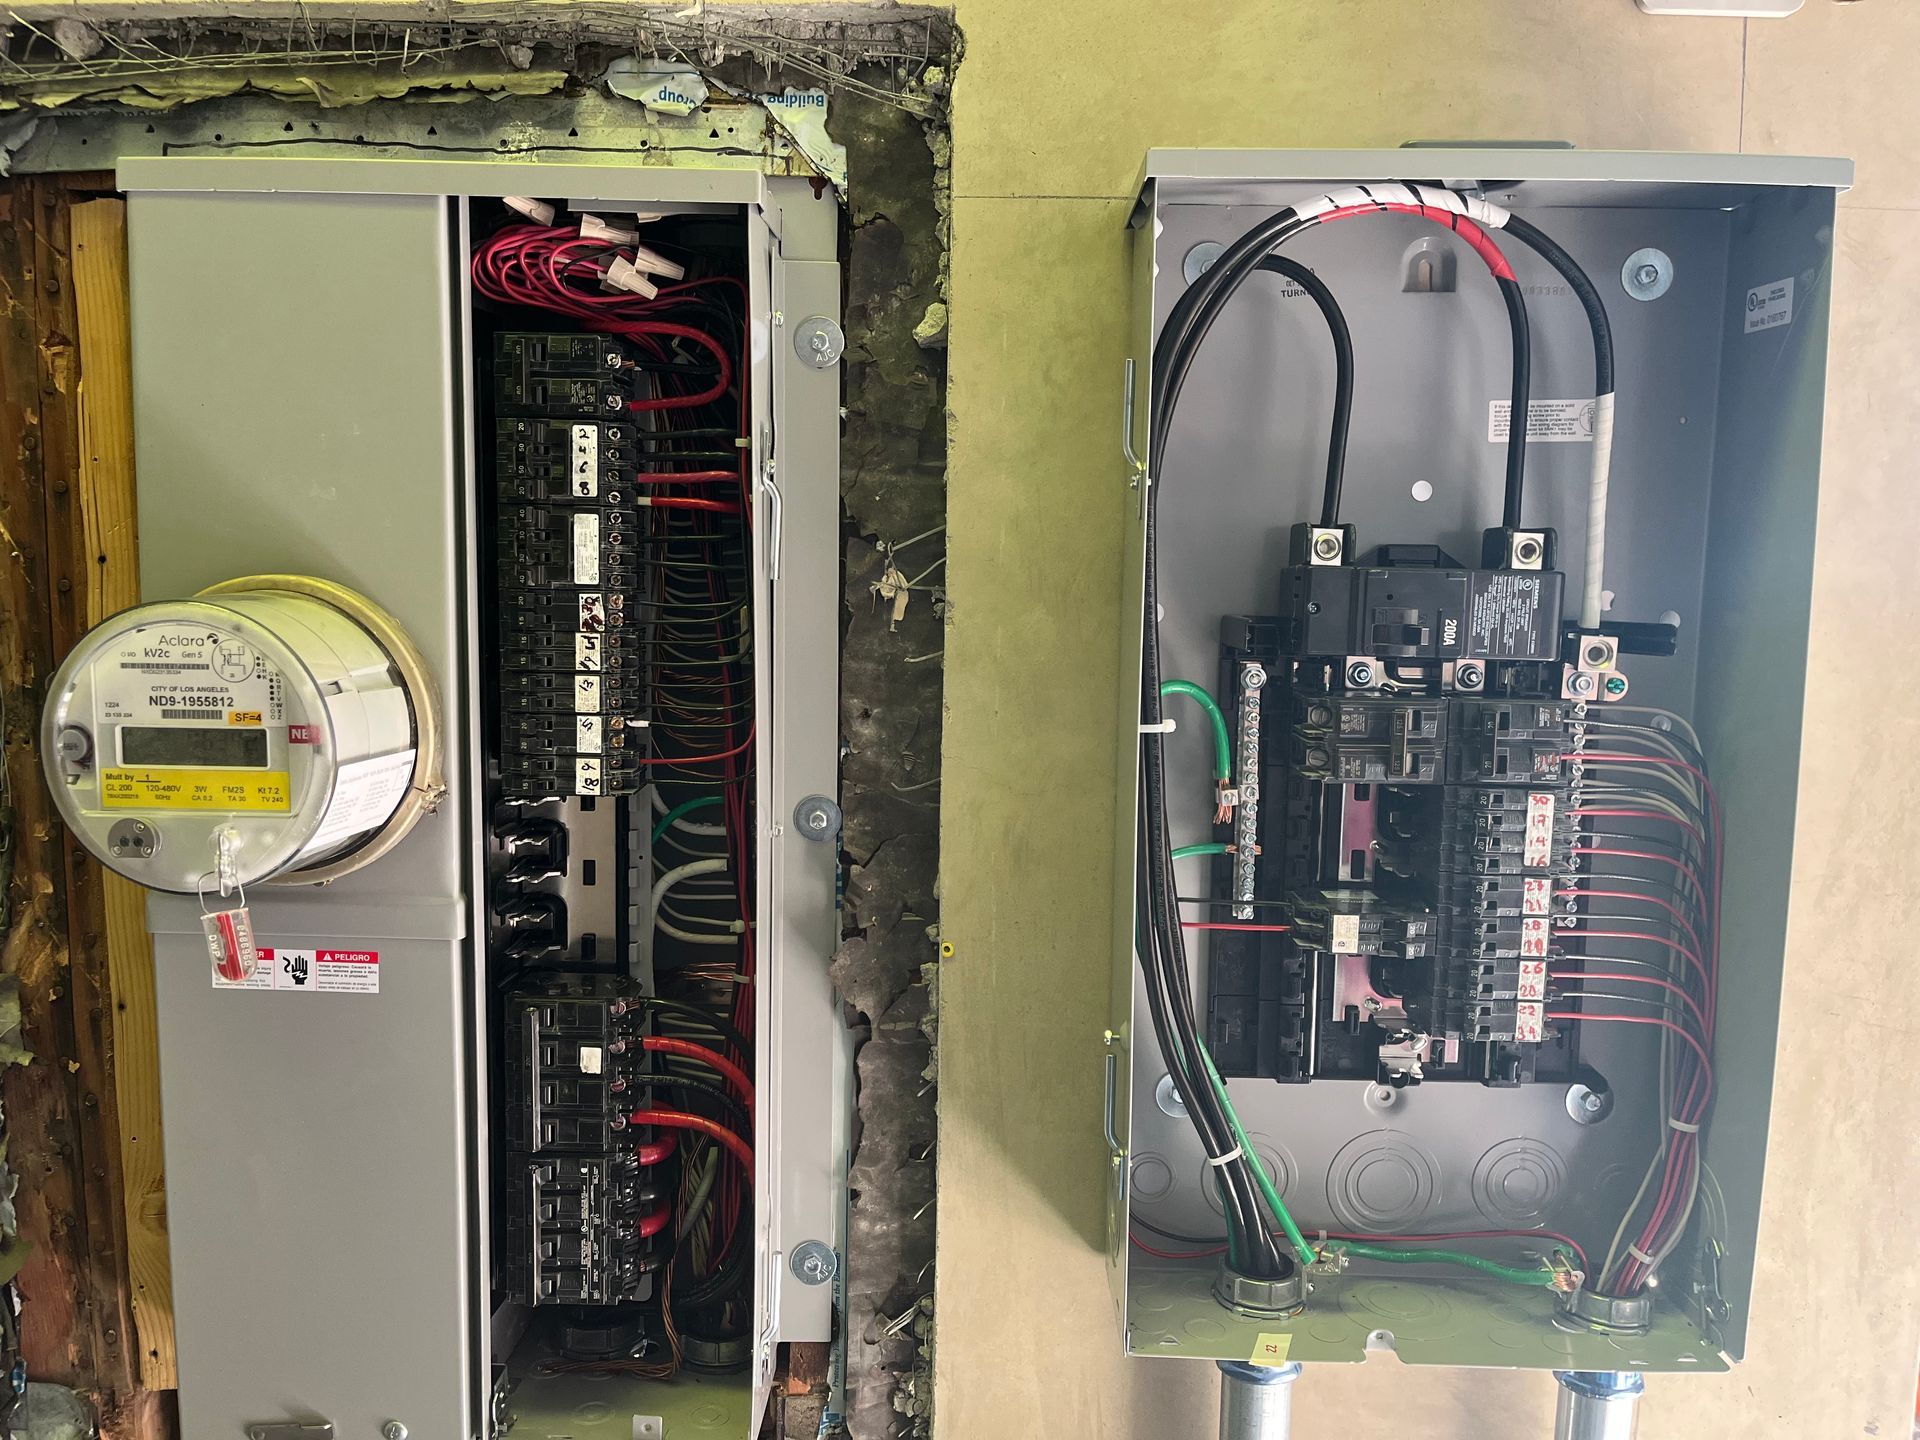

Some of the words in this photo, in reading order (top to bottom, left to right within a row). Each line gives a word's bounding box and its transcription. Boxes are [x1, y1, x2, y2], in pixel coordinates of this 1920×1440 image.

[1281, 289, 1310, 298] TURN
[816, 349, 835, 362] AJC
[518, 422, 524, 431] 20
[579, 428, 589, 439] 2
[519, 443, 525, 451] 50
[519, 465, 525, 473] 50
[579, 461, 588, 473] 6
[519, 486, 525, 494] 20
[520, 509, 525, 518] 40
[520, 554, 525, 562] 30
[518, 596, 524, 605] 20
[1443, 619, 1457, 646] 200A
[158, 635, 204, 647] Aclara
[144, 648, 170, 658] kV2c
[149, 695, 234, 707] ND9-1955812
[235, 712, 262, 722] SF=4
[125, 774, 134, 782] by
[194, 785, 208, 793] 3W
[222, 786, 245, 794] FM2S
[1480, 796, 1487, 805] 20
[1530, 794, 1550, 805] 30
[1480, 818, 1486, 827] 20
[1478, 841, 1484, 850] 20
[1530, 836, 1545, 847] 14
[1530, 854, 1547, 866] 16
[1477, 863, 1483, 872] 20
[1476, 885, 1483, 893] 20
[1475, 928, 1482, 936] 20
[208, 934, 219, 958] DWP
[1473, 948, 1480, 956] 20
[1522, 961, 1544, 974] 26
[1469, 990, 1476, 998] 20
[1520, 985, 1536, 997] 20
[1468, 1012, 1475, 1020] 20
[1467, 1032, 1474, 1040] 20
